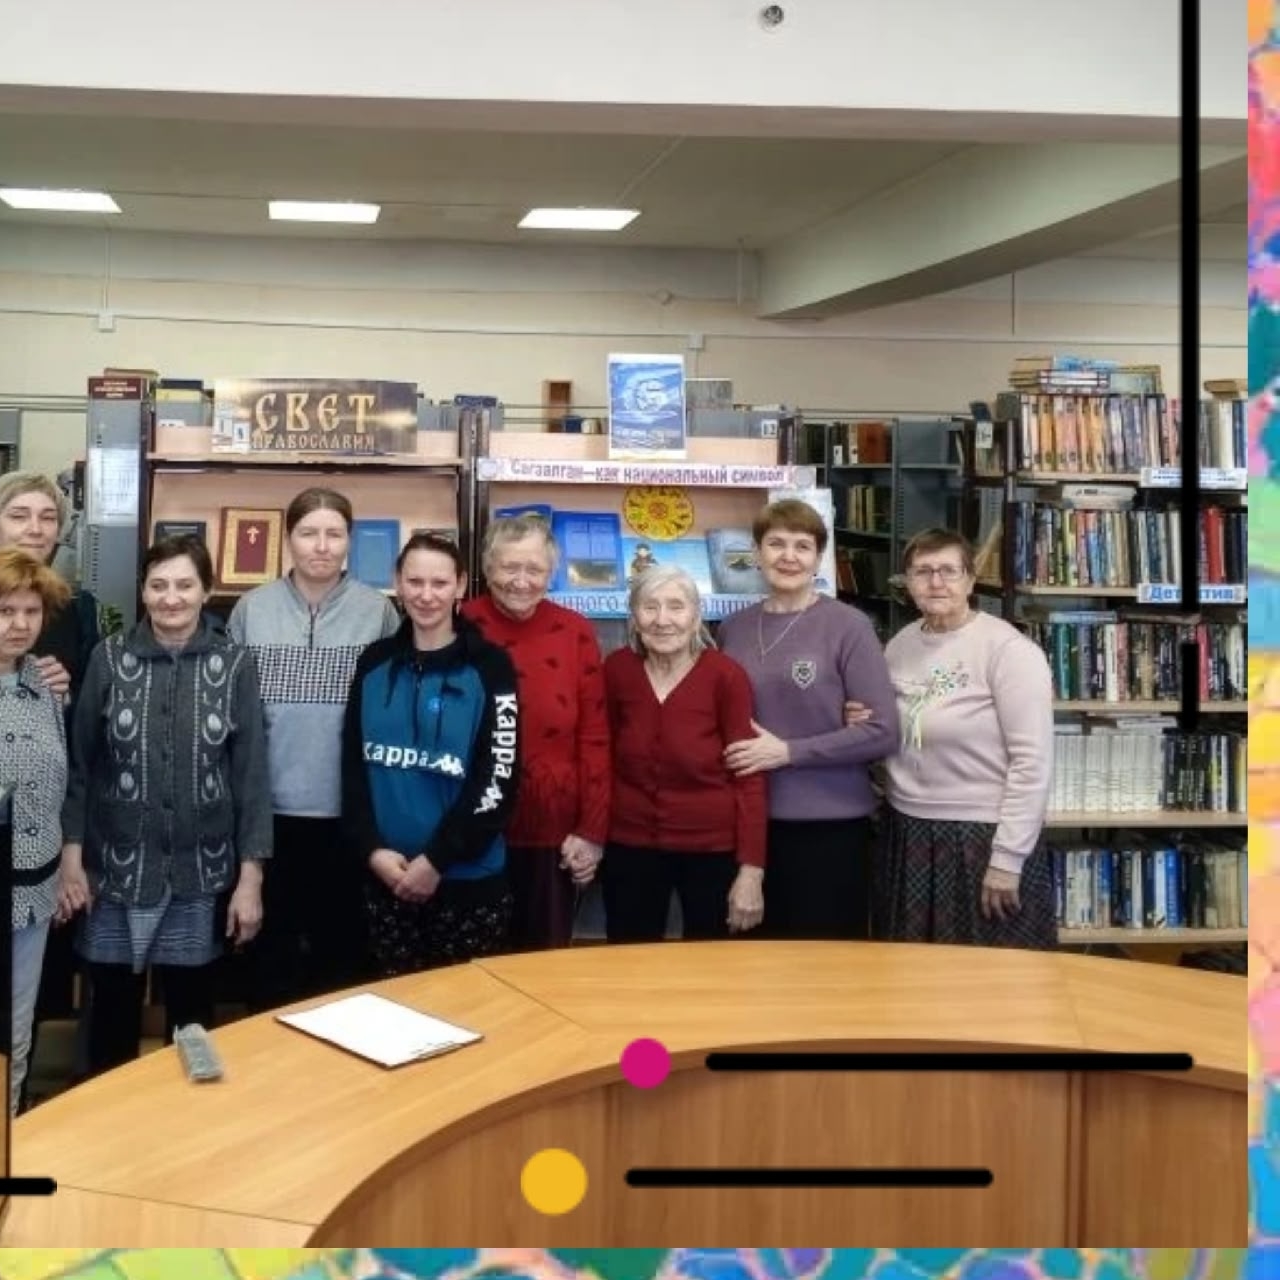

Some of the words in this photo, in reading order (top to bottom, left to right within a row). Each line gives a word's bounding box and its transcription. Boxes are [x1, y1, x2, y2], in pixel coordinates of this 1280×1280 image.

[251, 433, 376, 450] ПРАВОСЛАВИЯ
[623, 464, 728, 484] национальный
[1152, 586, 1233, 601] Деттив
[492, 692, 518, 780] Kappa
